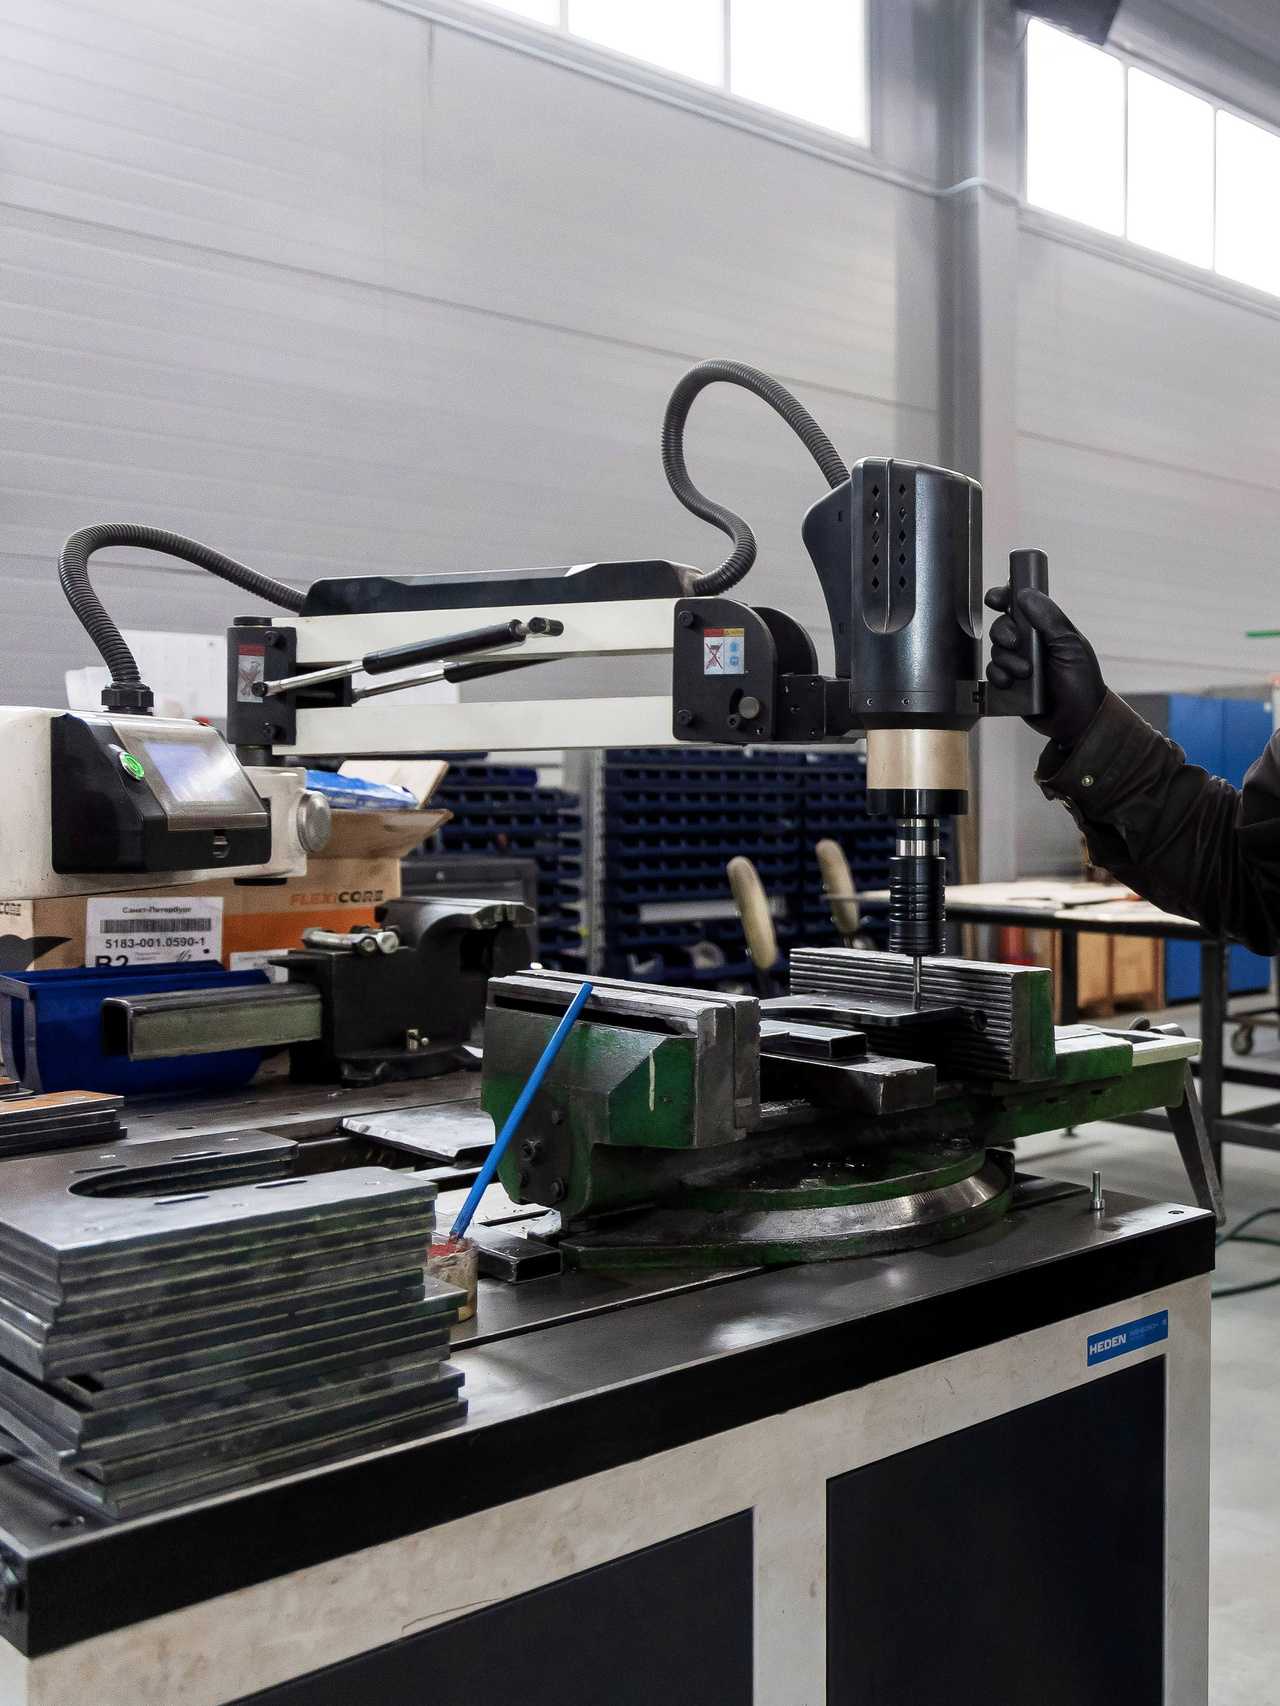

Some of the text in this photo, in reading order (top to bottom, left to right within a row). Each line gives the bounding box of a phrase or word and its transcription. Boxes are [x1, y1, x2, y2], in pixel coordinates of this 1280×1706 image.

[289, 890, 384, 906] FLEXICORE
[122, 905, 192, 915] Санкт-Петербург
[105, 937, 205, 949] 5183-001.0590-1
[1089, 1333, 1127, 1356] HEDEN
